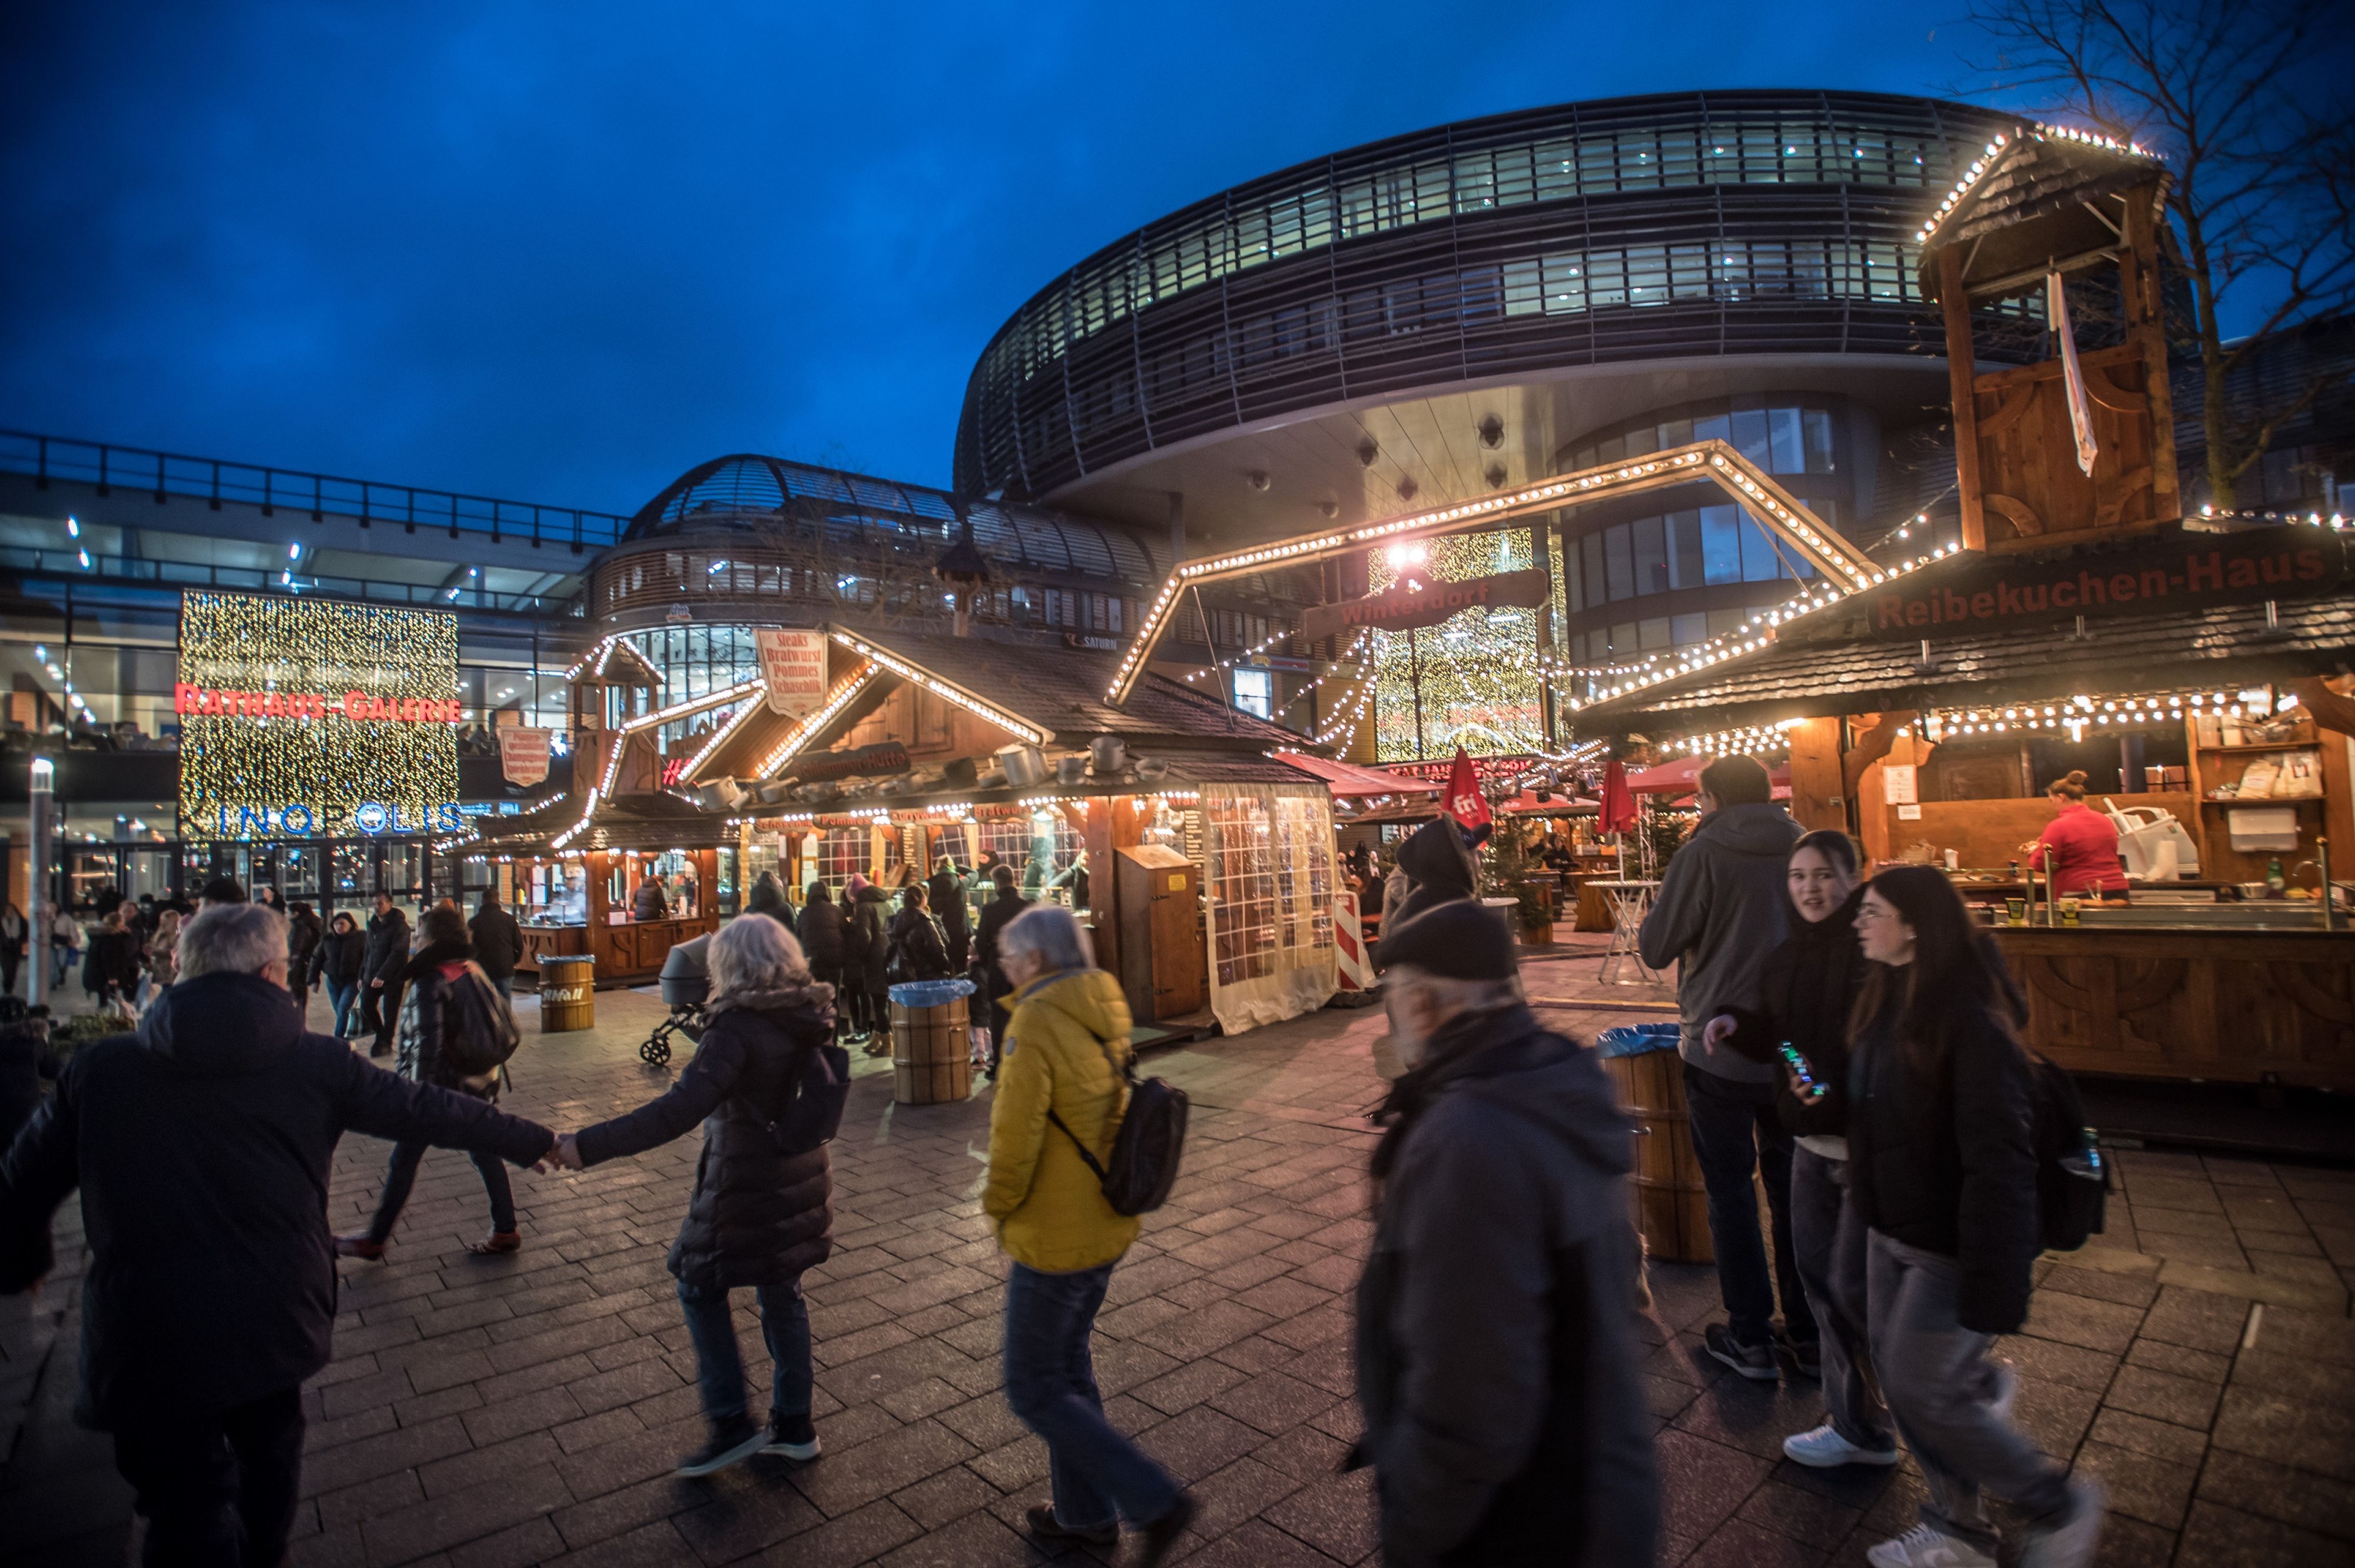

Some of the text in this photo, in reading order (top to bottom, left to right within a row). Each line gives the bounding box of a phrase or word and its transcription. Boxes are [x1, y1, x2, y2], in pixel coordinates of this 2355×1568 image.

[1879, 549, 2326, 629] Reibekuchen-Haus
[1342, 582, 1490, 624] Winterdorf
[777, 633, 808, 647] Steaks
[1084, 636, 1117, 650] SATURN
[766, 647, 821, 663] Bratwurst
[772, 663, 819, 677] Pommes
[773, 679, 821, 694] Schaschlik
[179, 802, 462, 835] KINOPOLIS
[821, 816, 870, 826] Pommes
